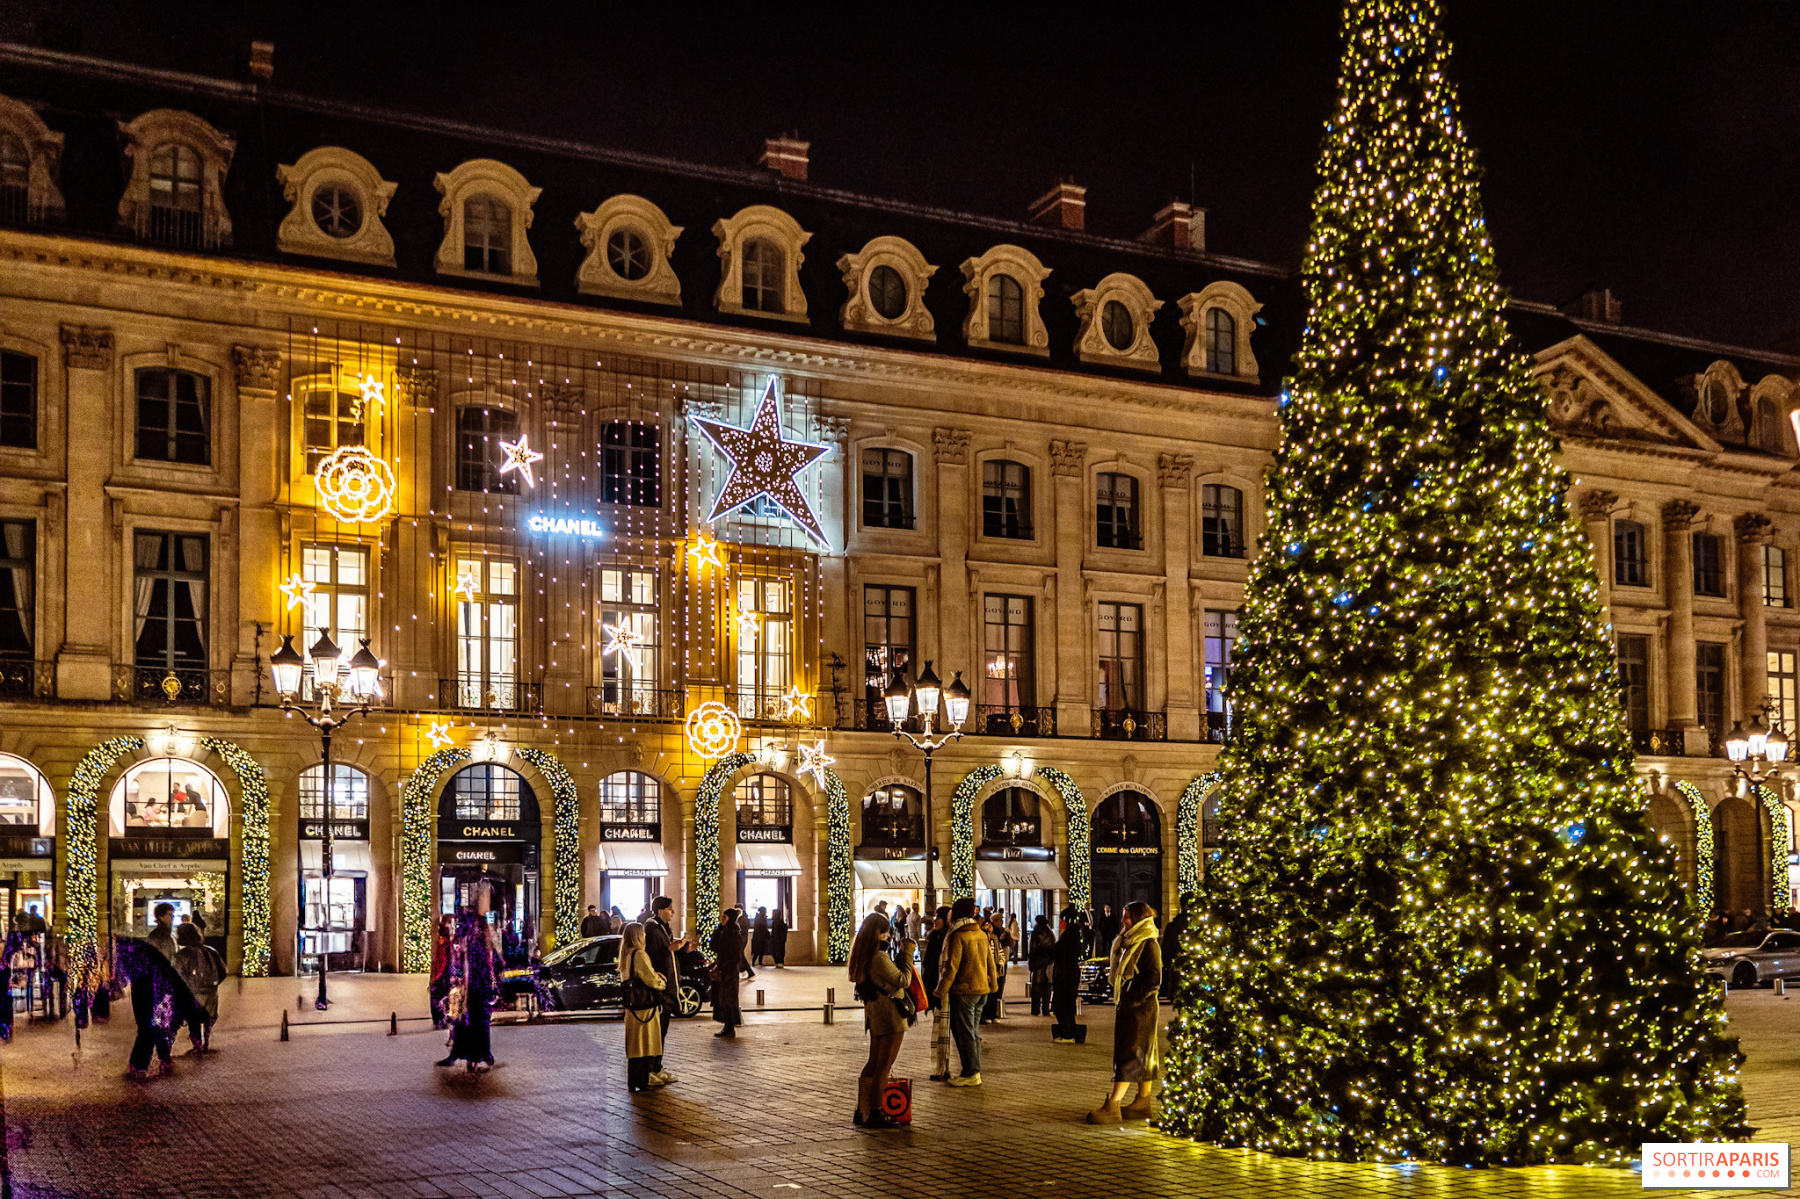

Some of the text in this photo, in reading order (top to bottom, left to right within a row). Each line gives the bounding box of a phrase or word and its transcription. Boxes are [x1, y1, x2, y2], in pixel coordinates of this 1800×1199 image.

[529, 516, 602, 536] CHANEL
[985, 607, 1022, 615] GOYRD
[1098, 614, 1132, 622] GOYRD
[463, 826, 515, 837] CHANEL
[604, 828, 653, 839] CHANEL
[739, 830, 785, 841] CHANEL
[456, 851, 496, 860] CHANEL
[881, 872, 921, 886] PIAGET
[1002, 872, 1040, 886] PIAGET
